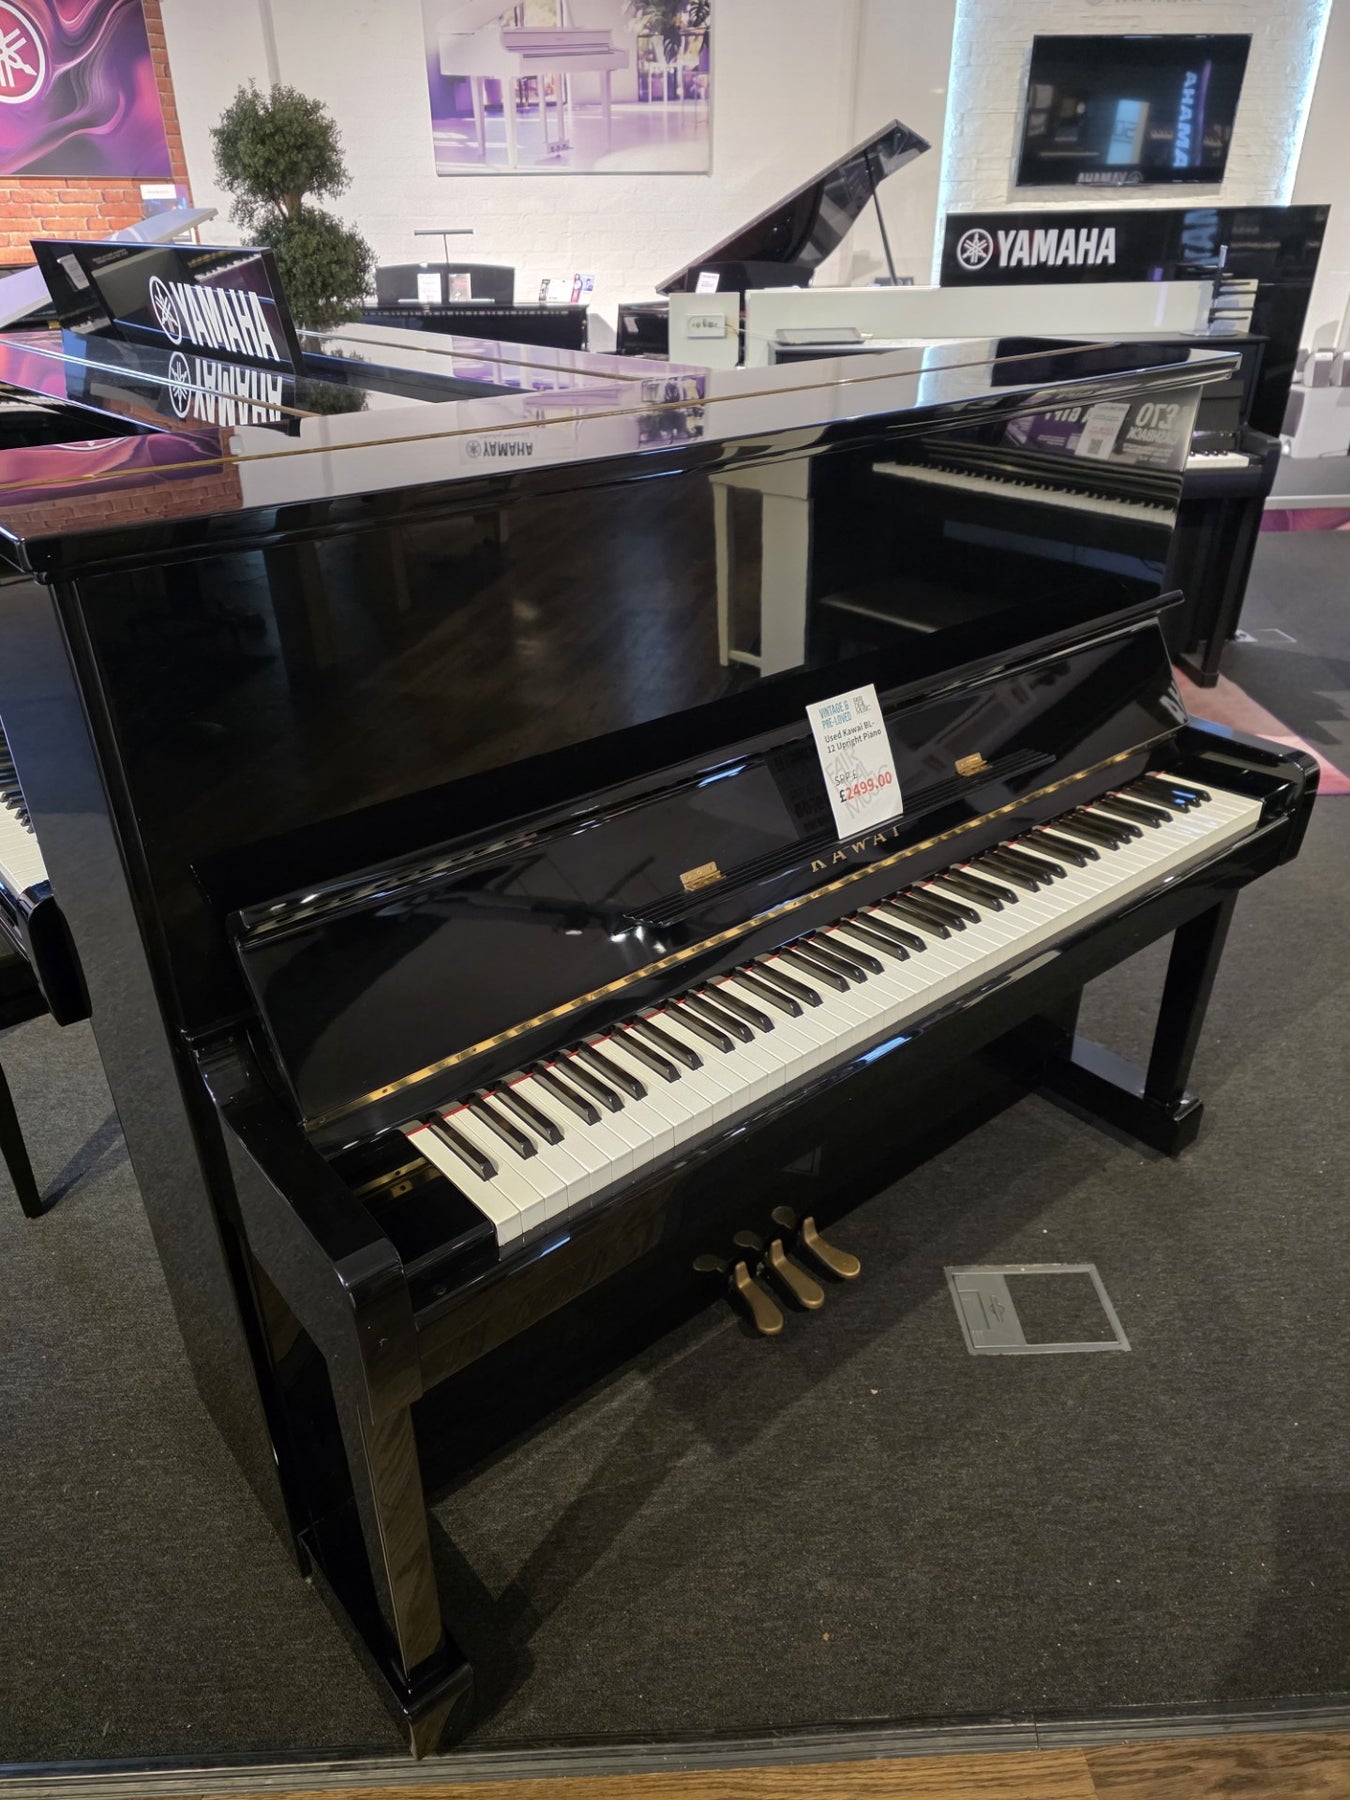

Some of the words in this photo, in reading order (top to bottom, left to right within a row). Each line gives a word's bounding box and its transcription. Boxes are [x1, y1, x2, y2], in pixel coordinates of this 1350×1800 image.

[997, 227, 1117, 267] YAMAHA
[168, 281, 281, 362] YAMAHA
[819, 702, 845, 719] VINTAGE
[821, 711, 853, 730] PRE-LOVED
[824, 731, 843, 744] Used
[842, 722, 863, 737] Kawai
[827, 744, 836, 754] 12
[836, 736, 863, 751] Upright
[863, 729, 882, 741] Piano
[839, 771, 893, 804] £2499.00
